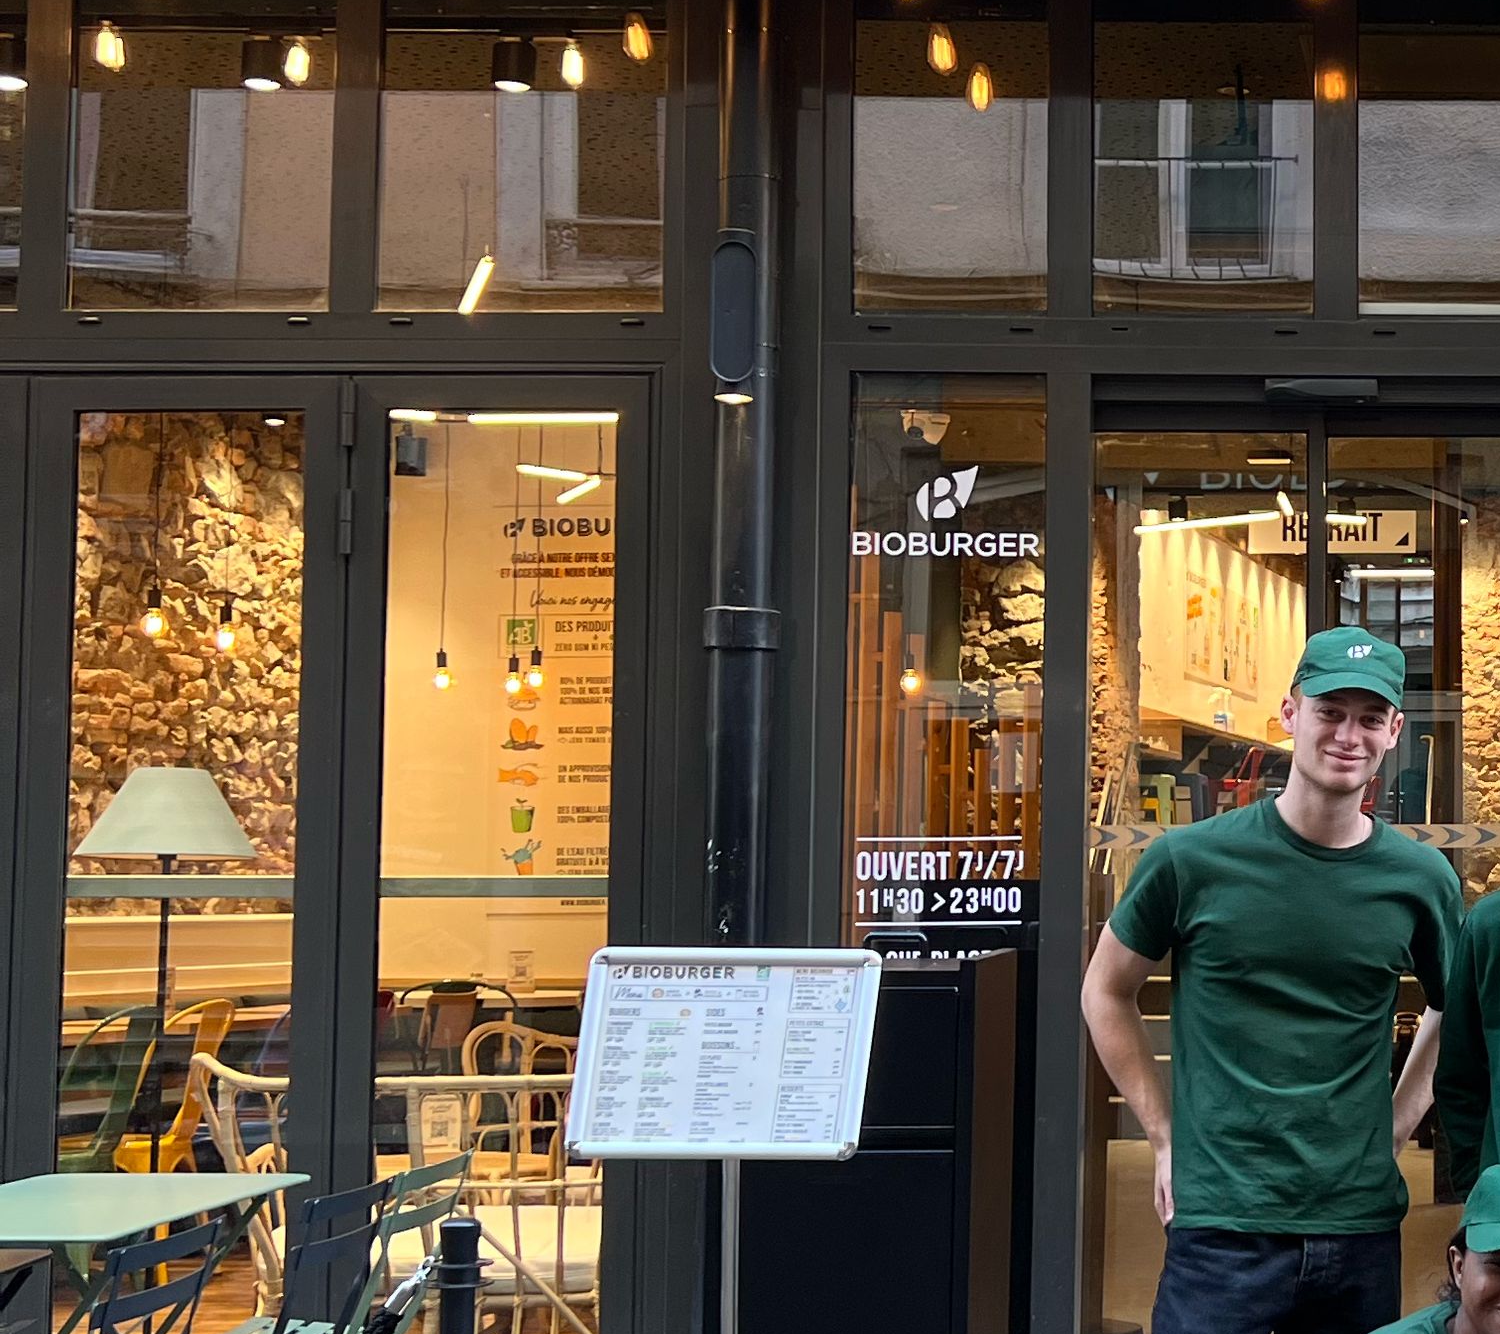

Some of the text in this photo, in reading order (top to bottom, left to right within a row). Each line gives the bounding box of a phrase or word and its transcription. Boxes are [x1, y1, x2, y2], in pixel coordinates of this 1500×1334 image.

[1282, 512, 1383, 542] RERAIT
[852, 531, 1040, 557] BIOBURGER
[555, 620, 573, 632] DES
[856, 850, 951, 881] OUVERT
[856, 888, 925, 914] 11H30
[950, 886, 1022, 914] 23H00
[632, 966, 735, 980] BIOBURGER
